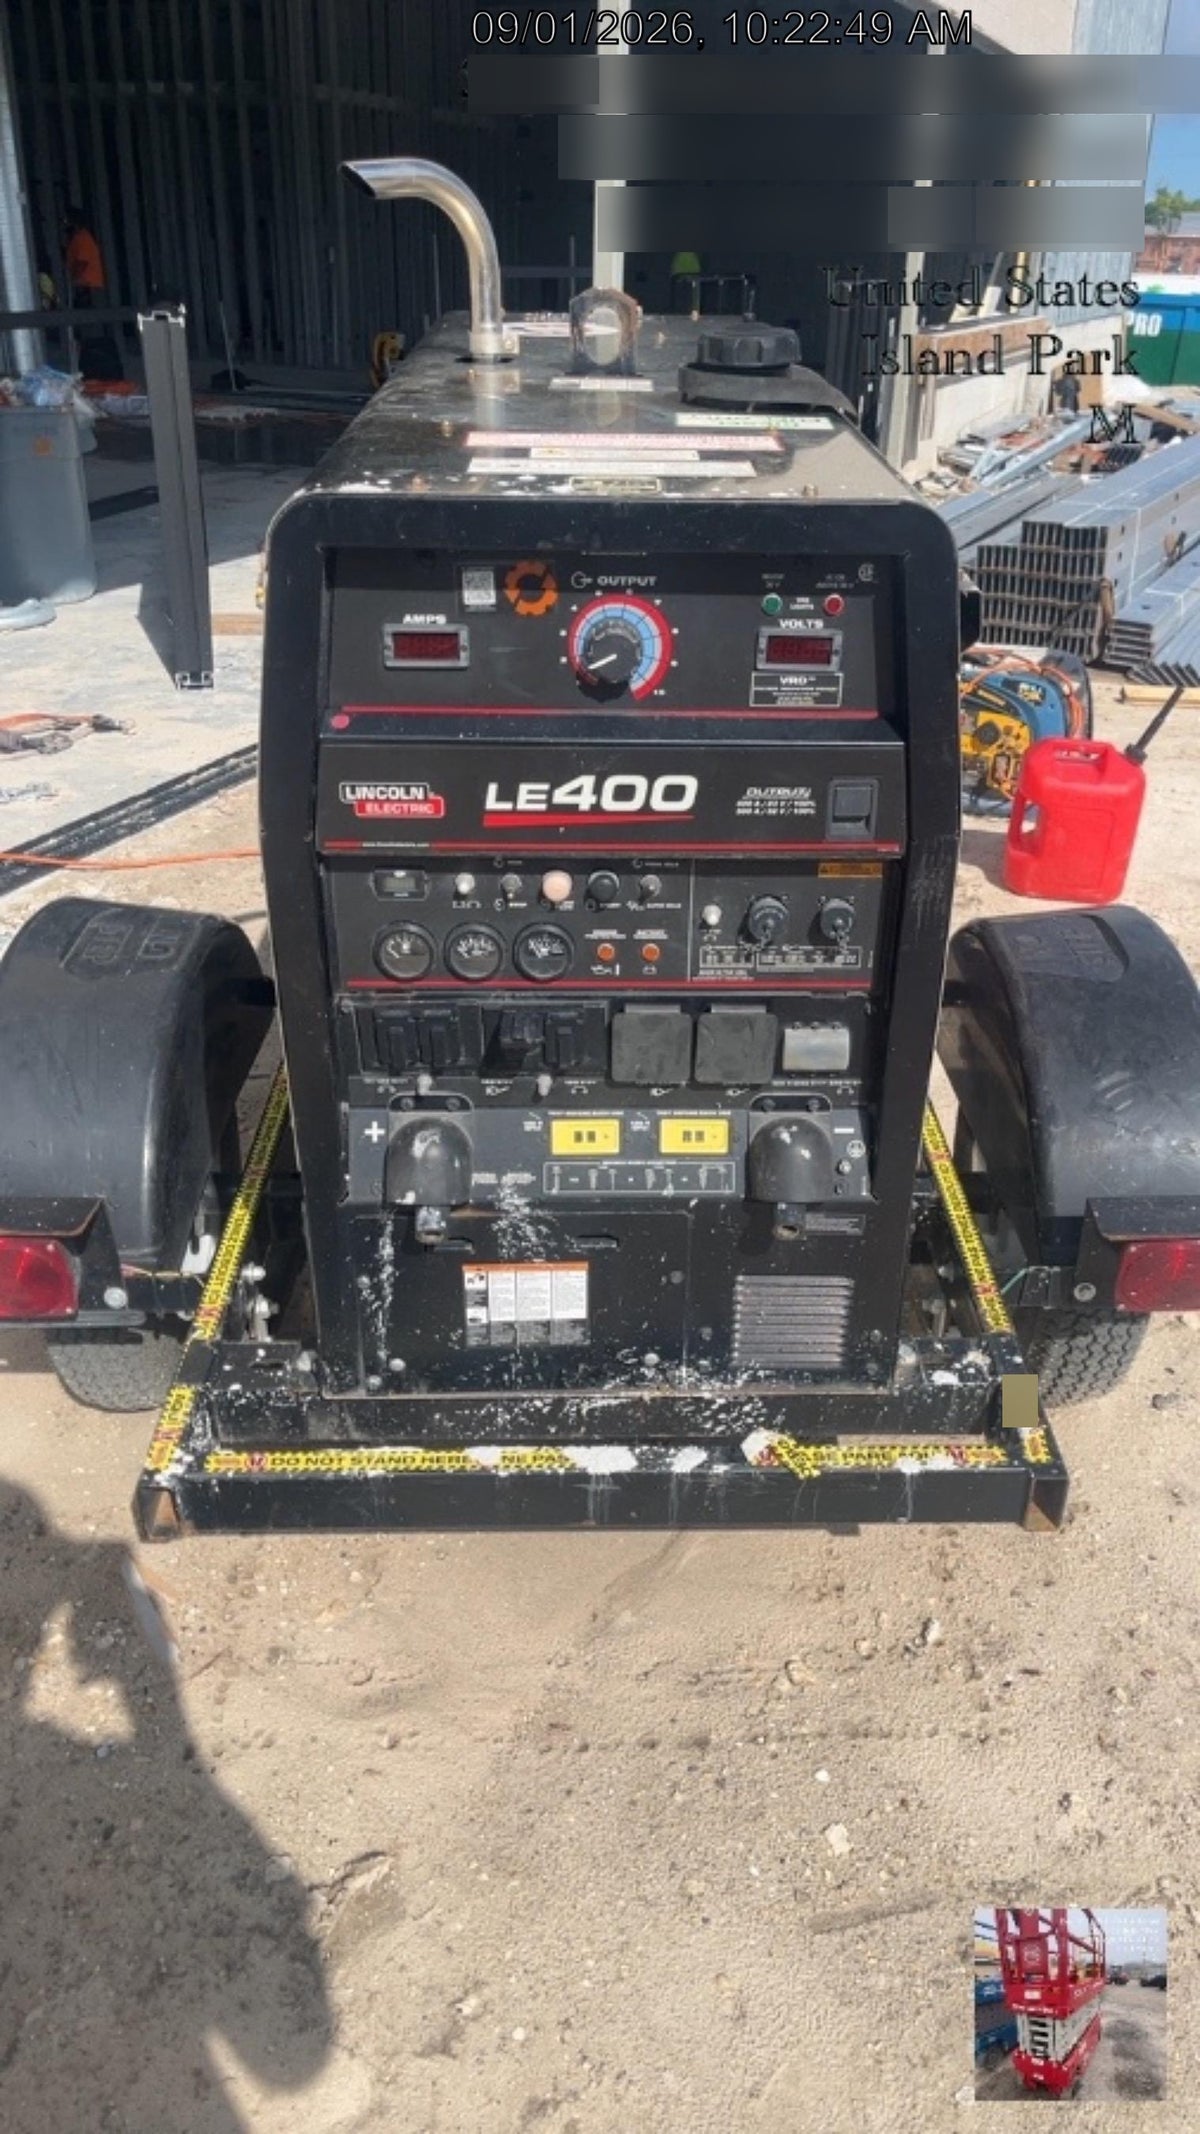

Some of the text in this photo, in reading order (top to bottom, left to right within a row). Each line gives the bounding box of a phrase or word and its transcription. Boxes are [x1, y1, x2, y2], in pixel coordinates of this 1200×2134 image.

[596, 575, 658, 587] OUTPUT
[402, 613, 447, 625] AMPS
[779, 618, 824, 630] VOLTS
[345, 785, 425, 800] LINCOLN
[485, 774, 699, 812] LE400
[365, 802, 435, 815] ELECTRIC
[271, 1456, 300, 1467] DO
[305, 1456, 342, 1466] NOT
[350, 1455, 416, 1466] STAND
